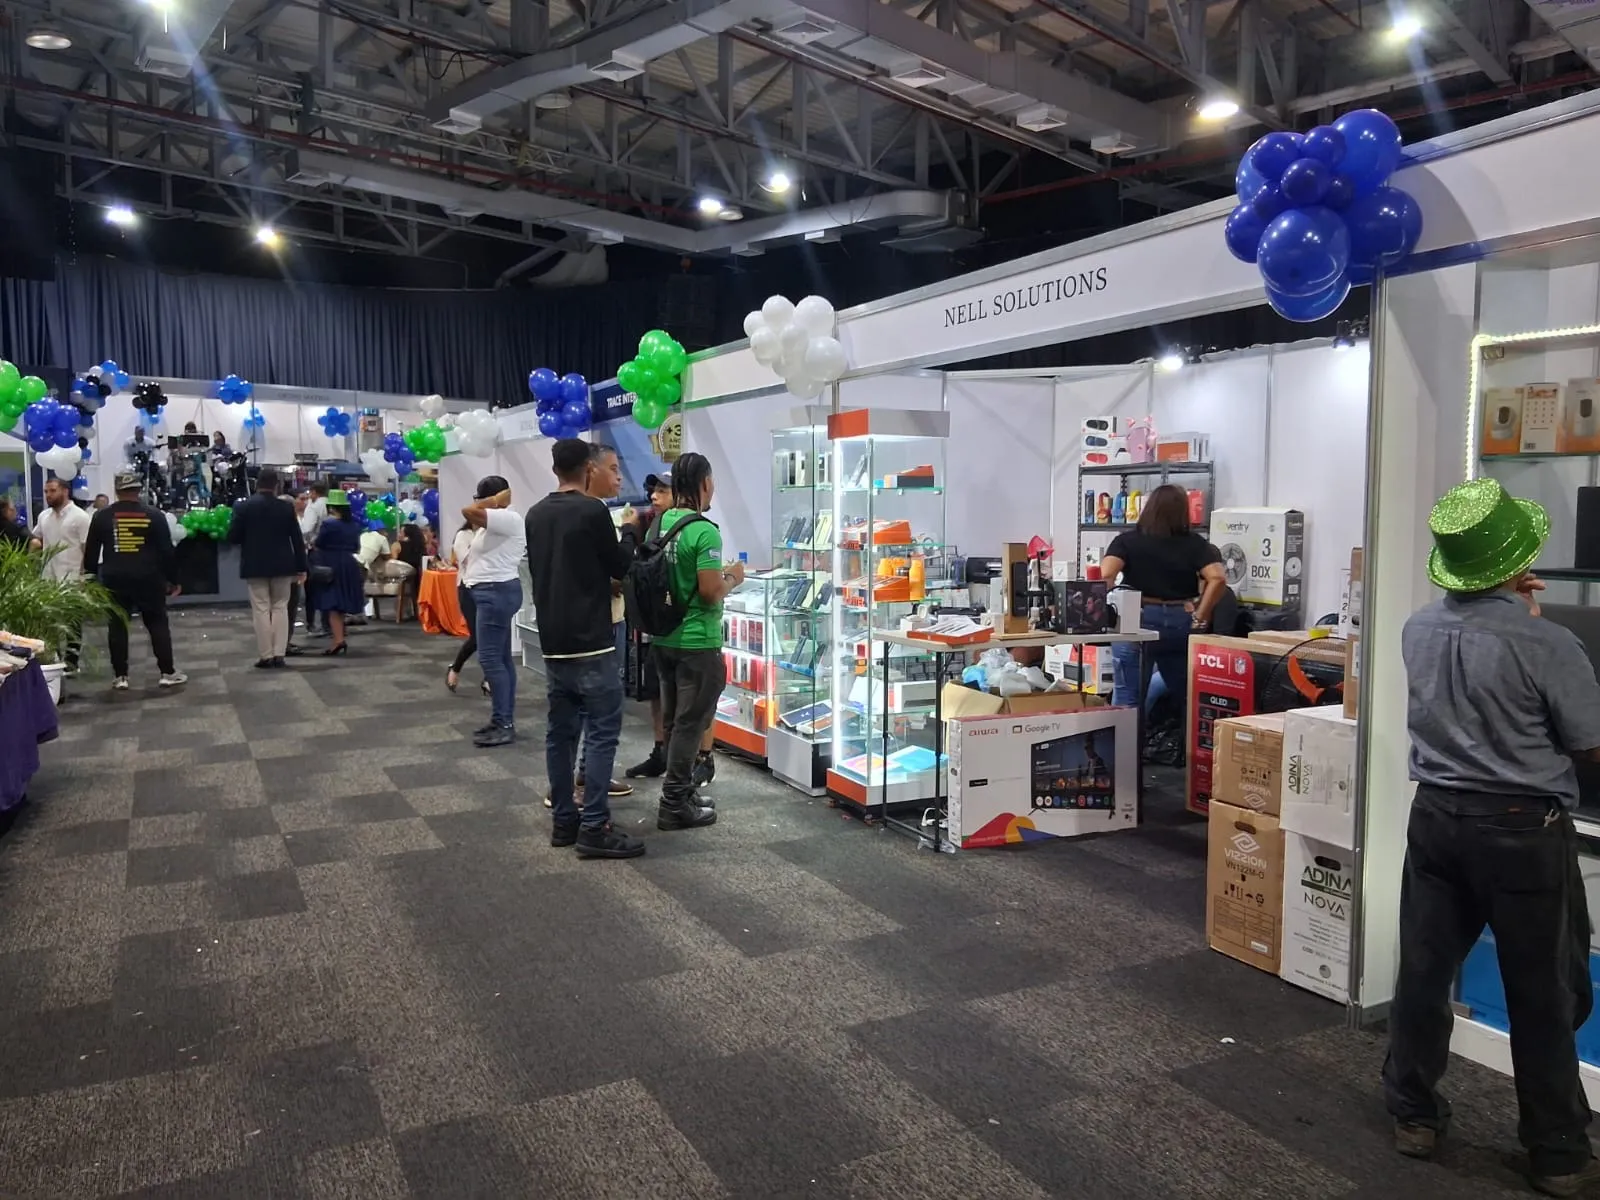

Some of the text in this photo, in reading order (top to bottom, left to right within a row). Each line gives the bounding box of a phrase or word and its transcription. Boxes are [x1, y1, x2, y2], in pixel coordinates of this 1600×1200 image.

[944, 267, 1107, 327] NELL SOLUTIONS
[606, 394, 622, 408] TRACE
[1262, 538, 1271, 557] 3
[1251, 565, 1271, 578] BOX
[1198, 653, 1225, 669] TCL
[1210, 696, 1228, 706] QLED
[1024, 722, 1061, 734] Google TV
[1288, 755, 1298, 793] ADINA
[1302, 764, 1311, 795] NOVA
[1224, 847, 1267, 869] VIZZION
[1303, 865, 1351, 891] ADINA
[1304, 892, 1345, 916] NOVA
